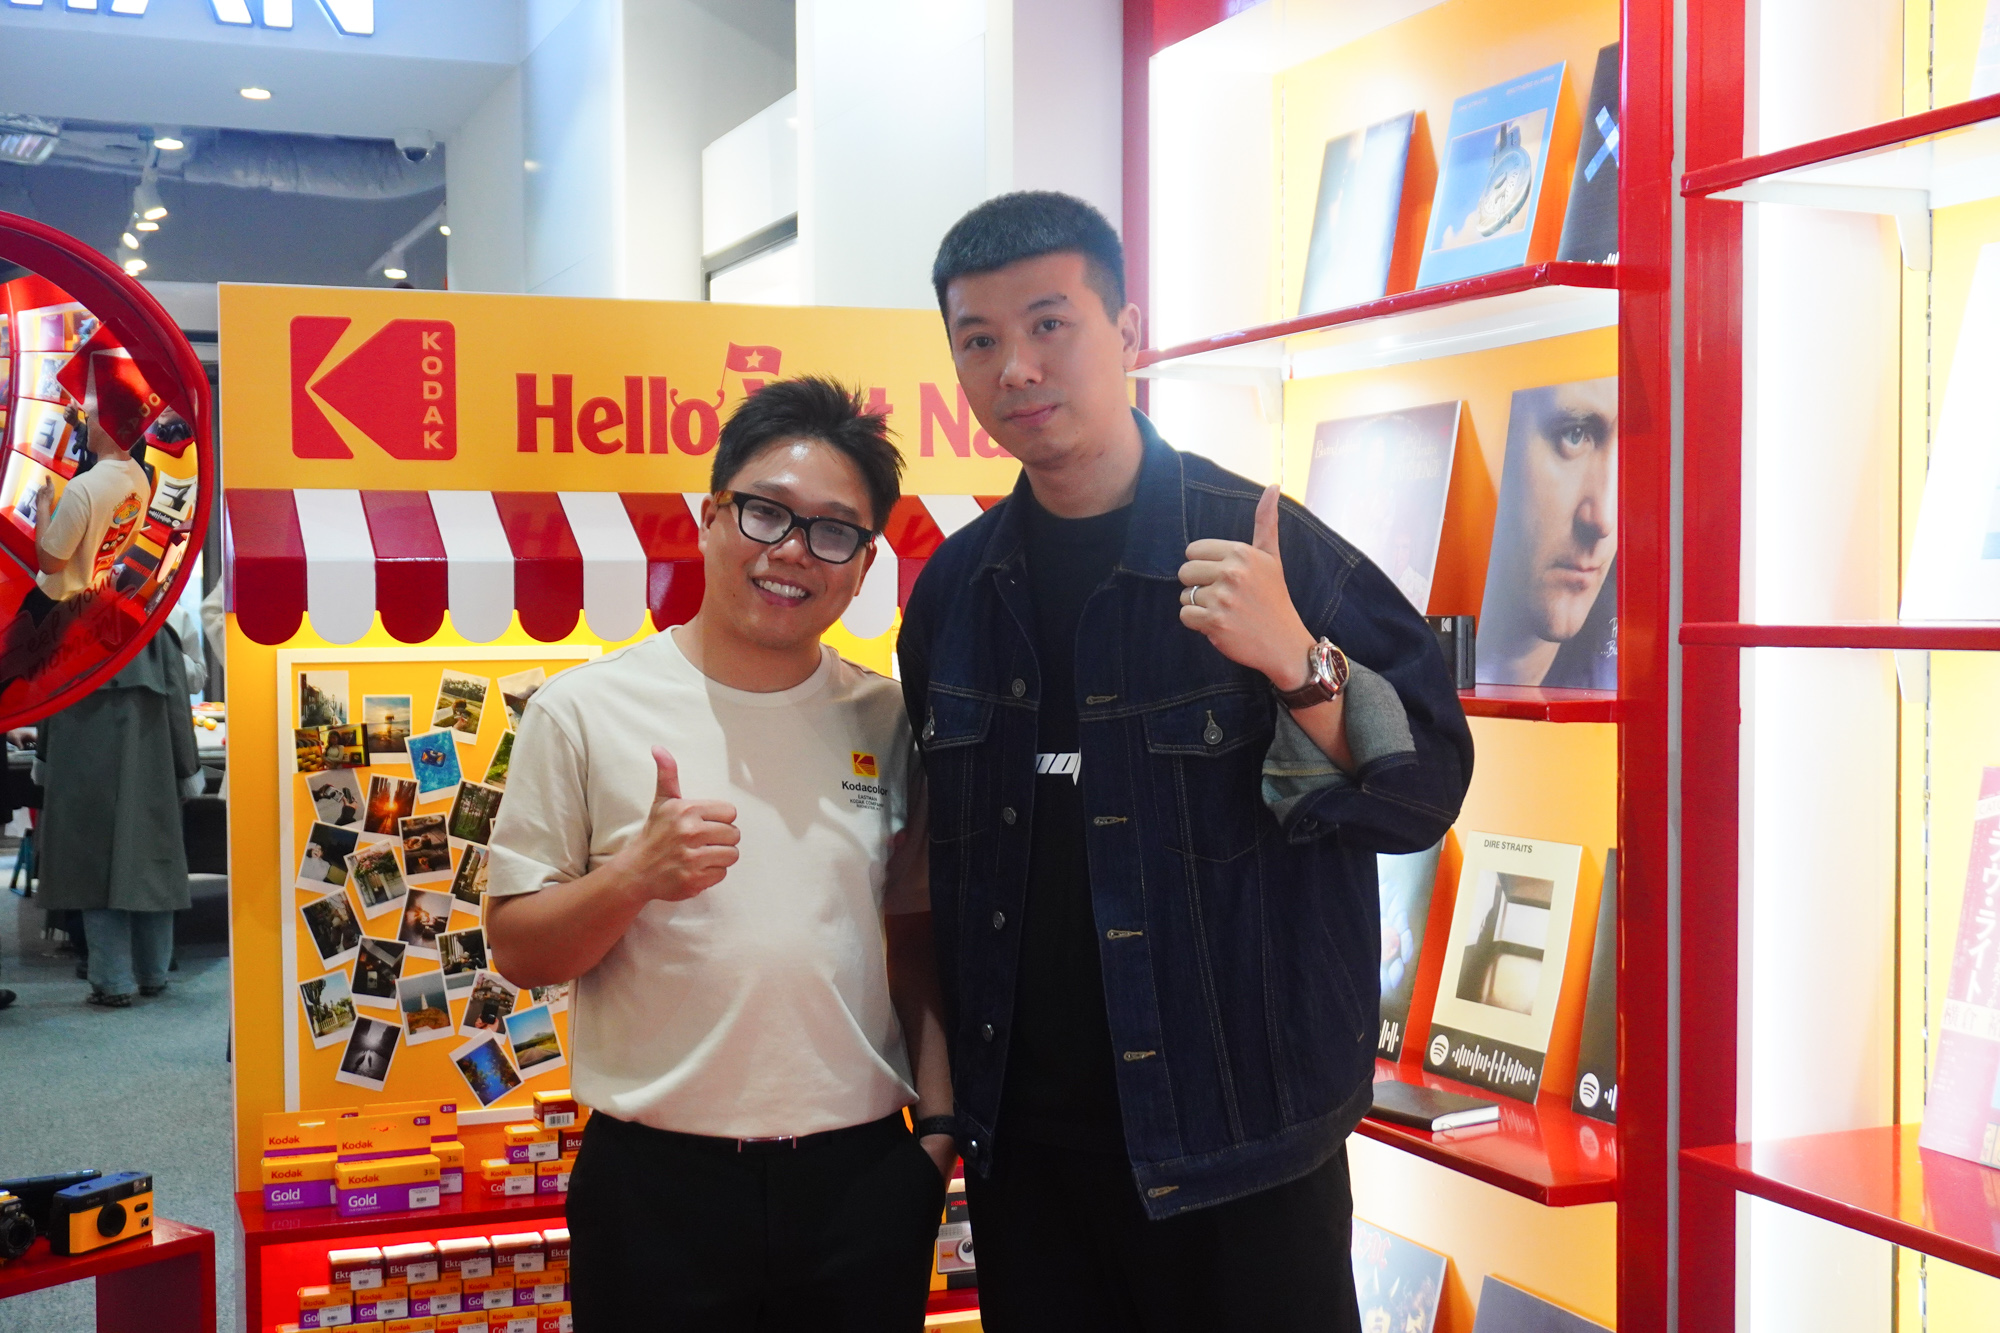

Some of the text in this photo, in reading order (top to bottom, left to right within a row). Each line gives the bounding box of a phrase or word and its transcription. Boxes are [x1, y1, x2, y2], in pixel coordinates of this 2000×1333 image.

[421, 331, 444, 449] KODAK
[516, 372, 722, 456] Hello
[919, 382, 1024, 458] Na
[841, 780, 888, 796] Kodacolor
[1484, 839, 1533, 854] DIRE STRAITS
[269, 1136, 300, 1146] Kodak
[342, 1140, 373, 1151] Kodak
[512, 1149, 529, 1159] Gol
[270, 1169, 303, 1179] Kodak
[542, 1165, 563, 1173] Kodak
[348, 1174, 380, 1185] Kodak
[541, 1179, 559, 1188] Gol
[490, 1183, 505, 1193] Col
[271, 1187, 301, 1202] Gold
[348, 1192, 377, 1208] Gold
[498, 1255, 515, 1263] Ekta
[390, 1265, 408, 1274] Ekta
[445, 1260, 461, 1269] Ekta
[335, 1270, 351, 1280] Ekta
[520, 1291, 535, 1300] Gol
[414, 1301, 430, 1311] Gol
[468, 1296, 484, 1306] Gol
[360, 1307, 378, 1317] Gol
[303, 1313, 320, 1323] Gol
[543, 1321, 560, 1330] Colo
